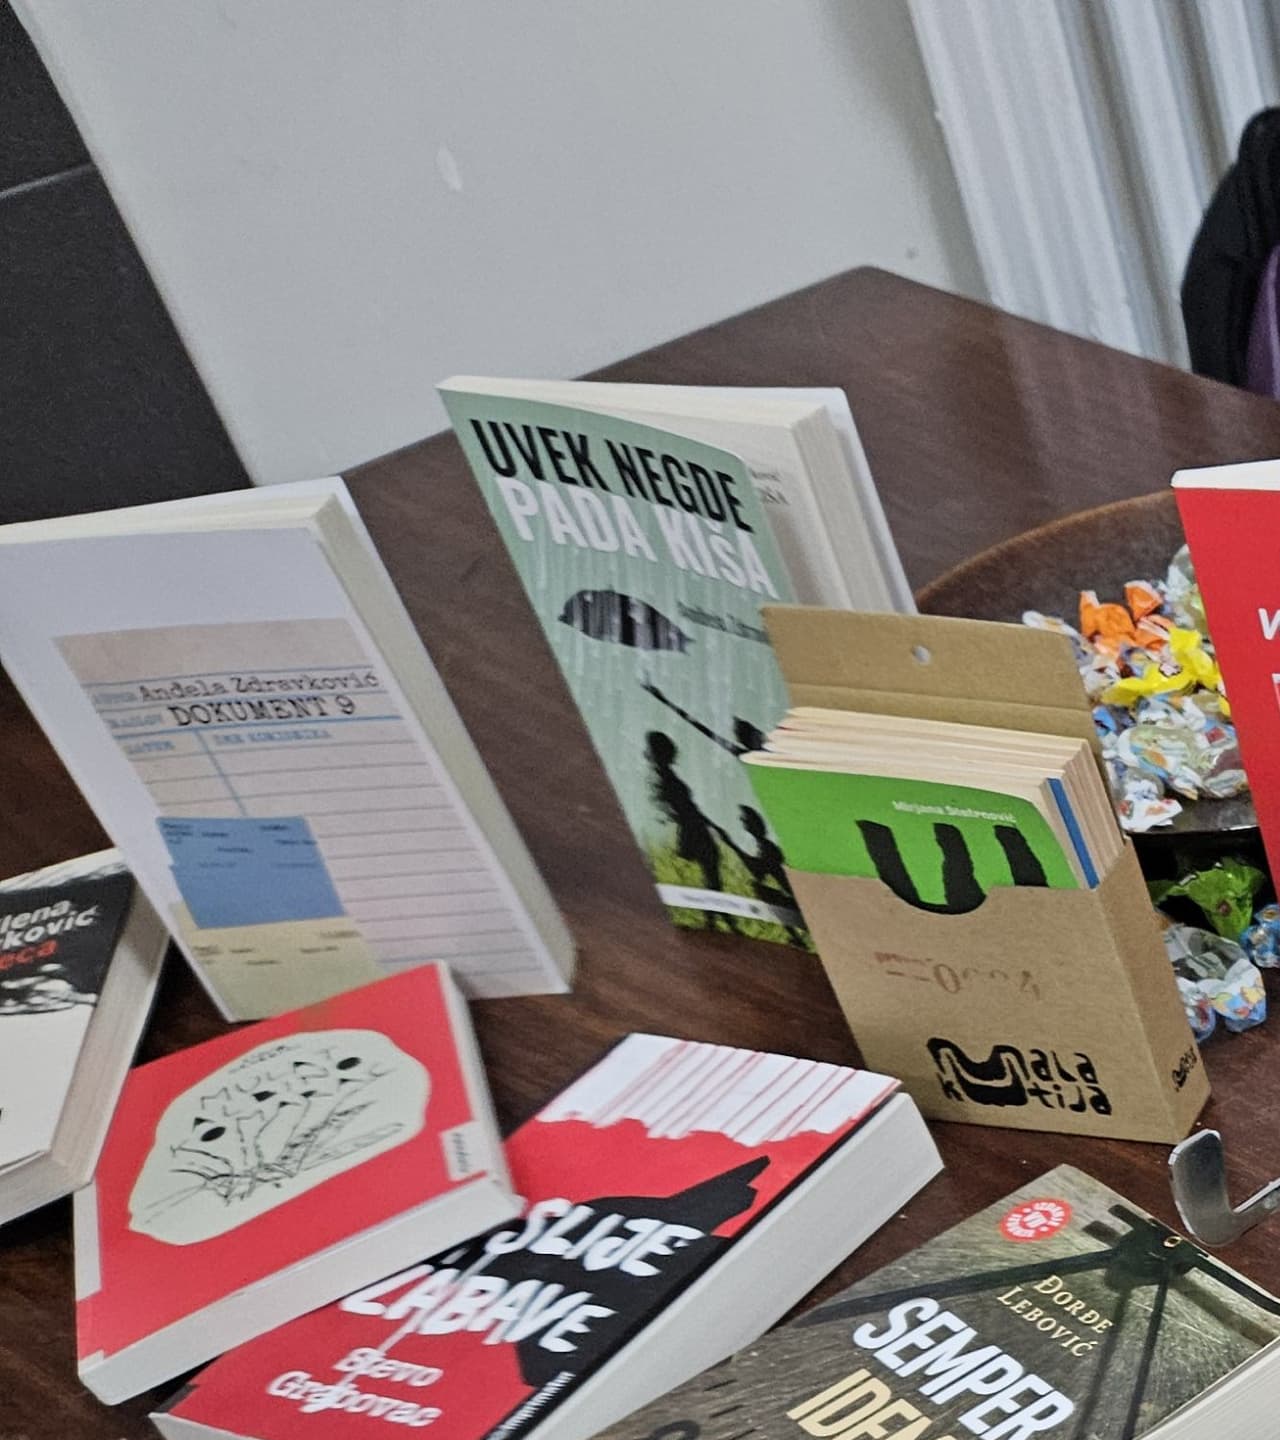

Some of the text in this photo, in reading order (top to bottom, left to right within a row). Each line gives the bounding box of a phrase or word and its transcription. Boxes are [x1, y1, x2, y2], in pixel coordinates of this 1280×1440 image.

[470, 419, 609, 490] UVEK
[604, 437, 755, 533] NEGDE
[499, 478, 657, 563] PADA
[652, 503, 780, 600] KIŠA
[139, 679, 227, 701] Anđela
[231, 671, 380, 694] Zdravković
[168, 694, 328, 728] DOKUMENT
[334, 695, 357, 716] 9
[0, 900, 72, 935] lena
[0, 905, 99, 950] ković
[339, 1263, 617, 1353] ZABAVE
[267, 1371, 443, 1428] Grabovac
